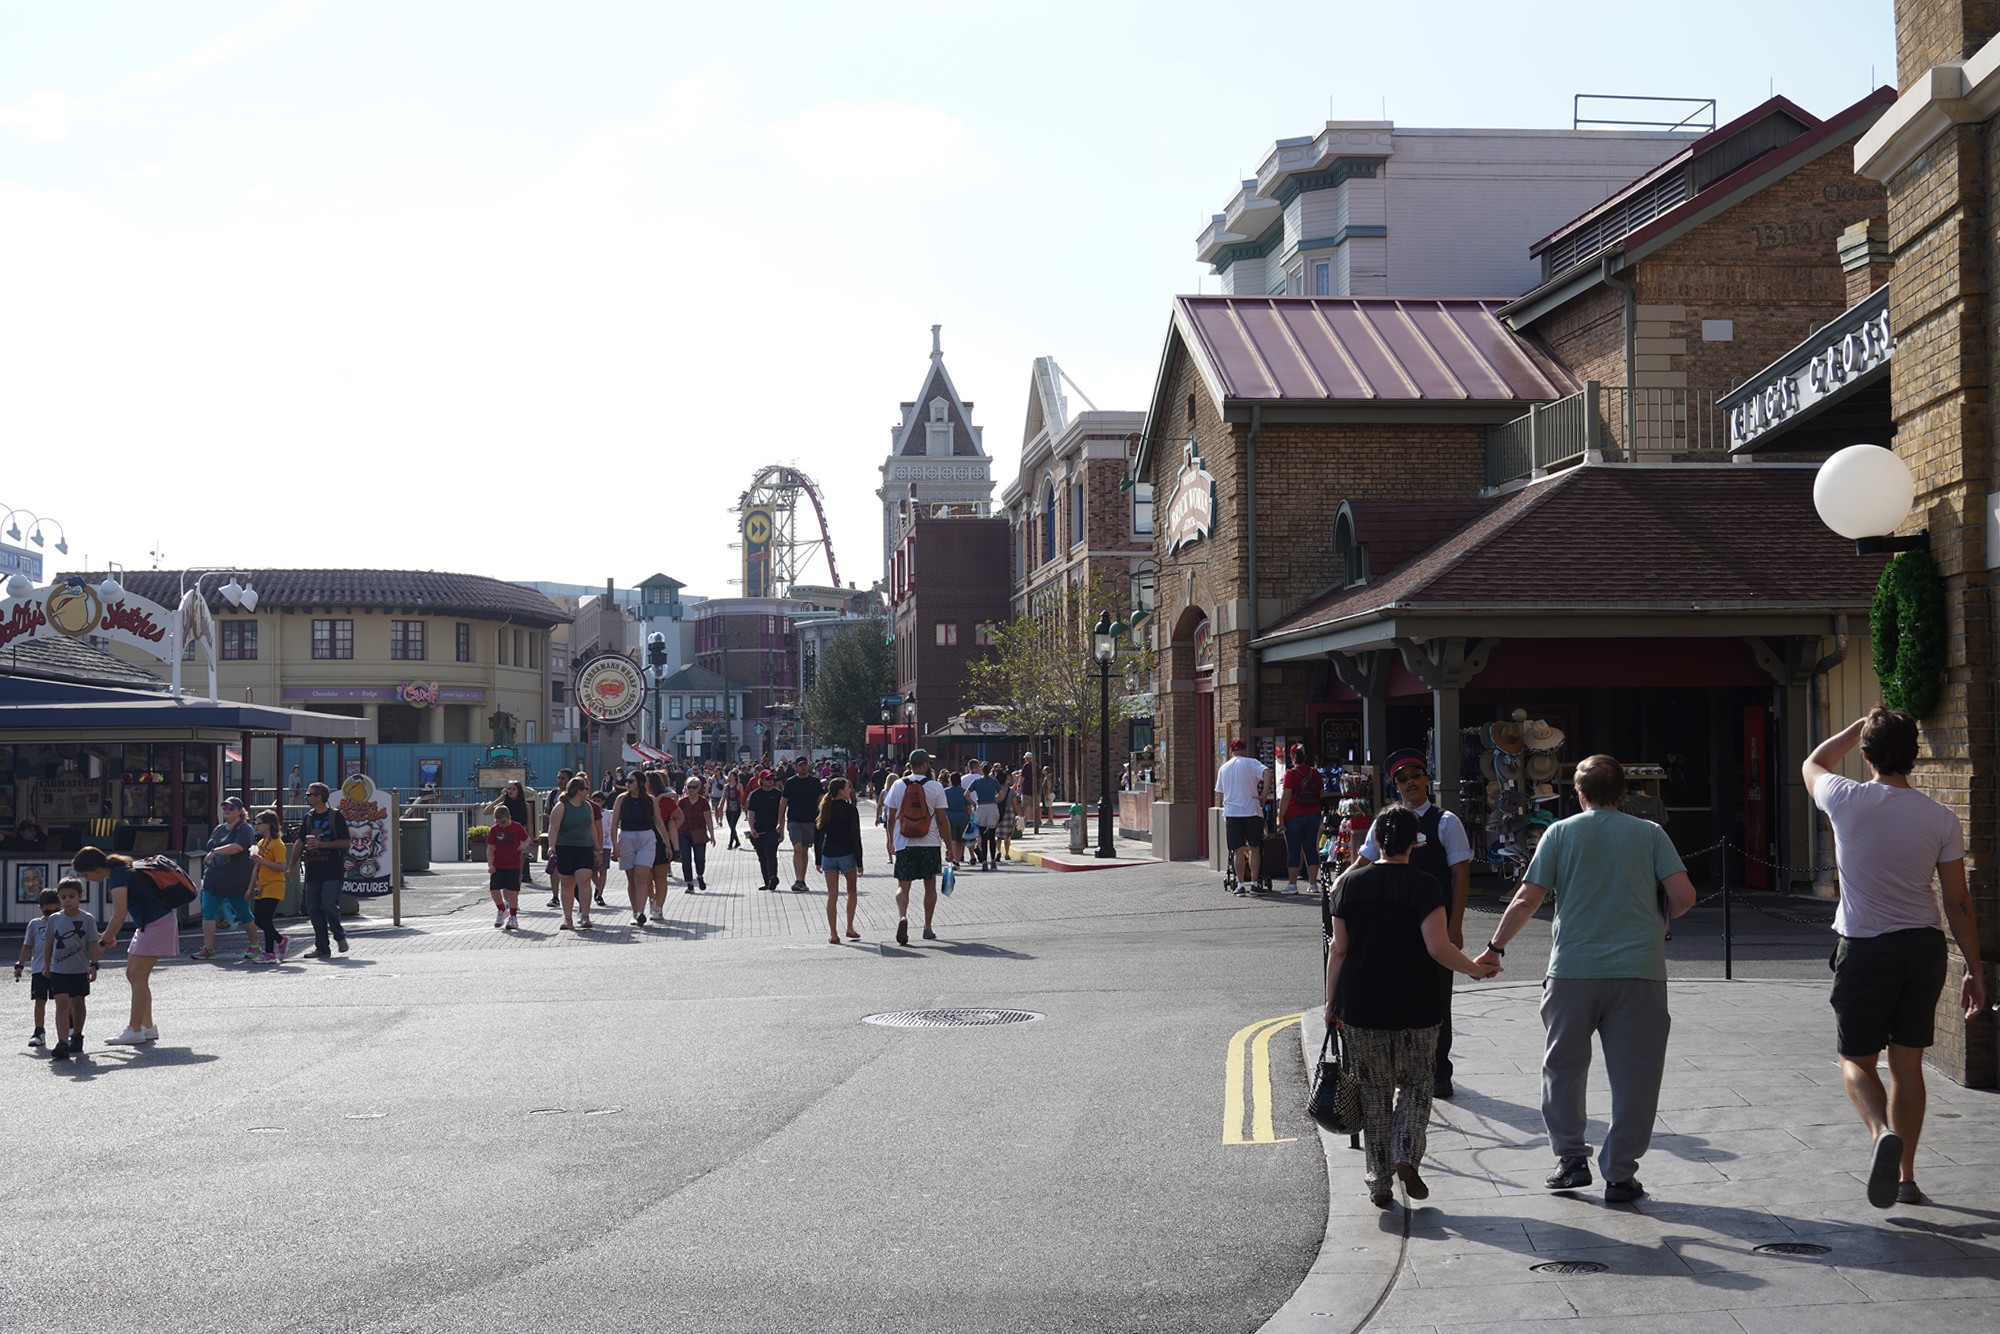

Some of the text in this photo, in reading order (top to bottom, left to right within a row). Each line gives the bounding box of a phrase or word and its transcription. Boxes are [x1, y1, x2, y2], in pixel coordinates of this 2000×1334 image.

[1753, 215, 1846, 252] BRIC
[1732, 308, 1890, 440] KING'S CROSS
[39, 779, 101, 788] CARICATURES
